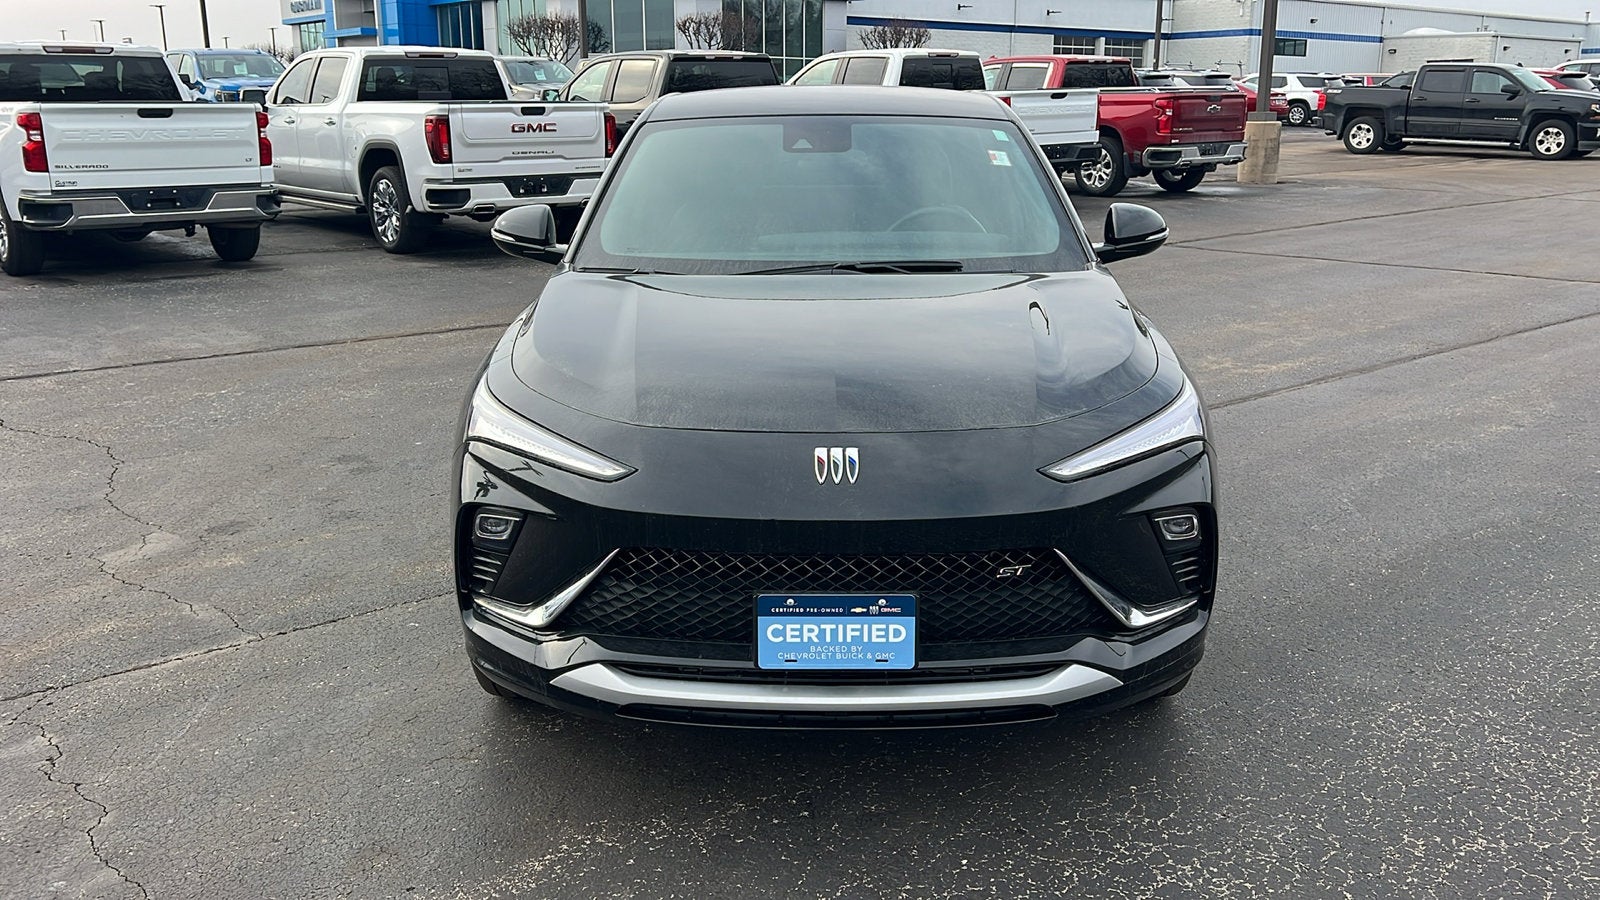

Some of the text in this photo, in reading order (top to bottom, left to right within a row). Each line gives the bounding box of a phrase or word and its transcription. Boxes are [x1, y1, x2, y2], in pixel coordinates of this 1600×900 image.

[511, 122, 557, 133] GMC
[62, 127, 246, 141] CHEVROLET
[997, 564, 1031, 578] ST
[766, 623, 907, 643] CERTIFIED
[810, 645, 863, 653] BACKED BY
[777, 652, 896, 660] CHEVROLET BUICK & GMC
